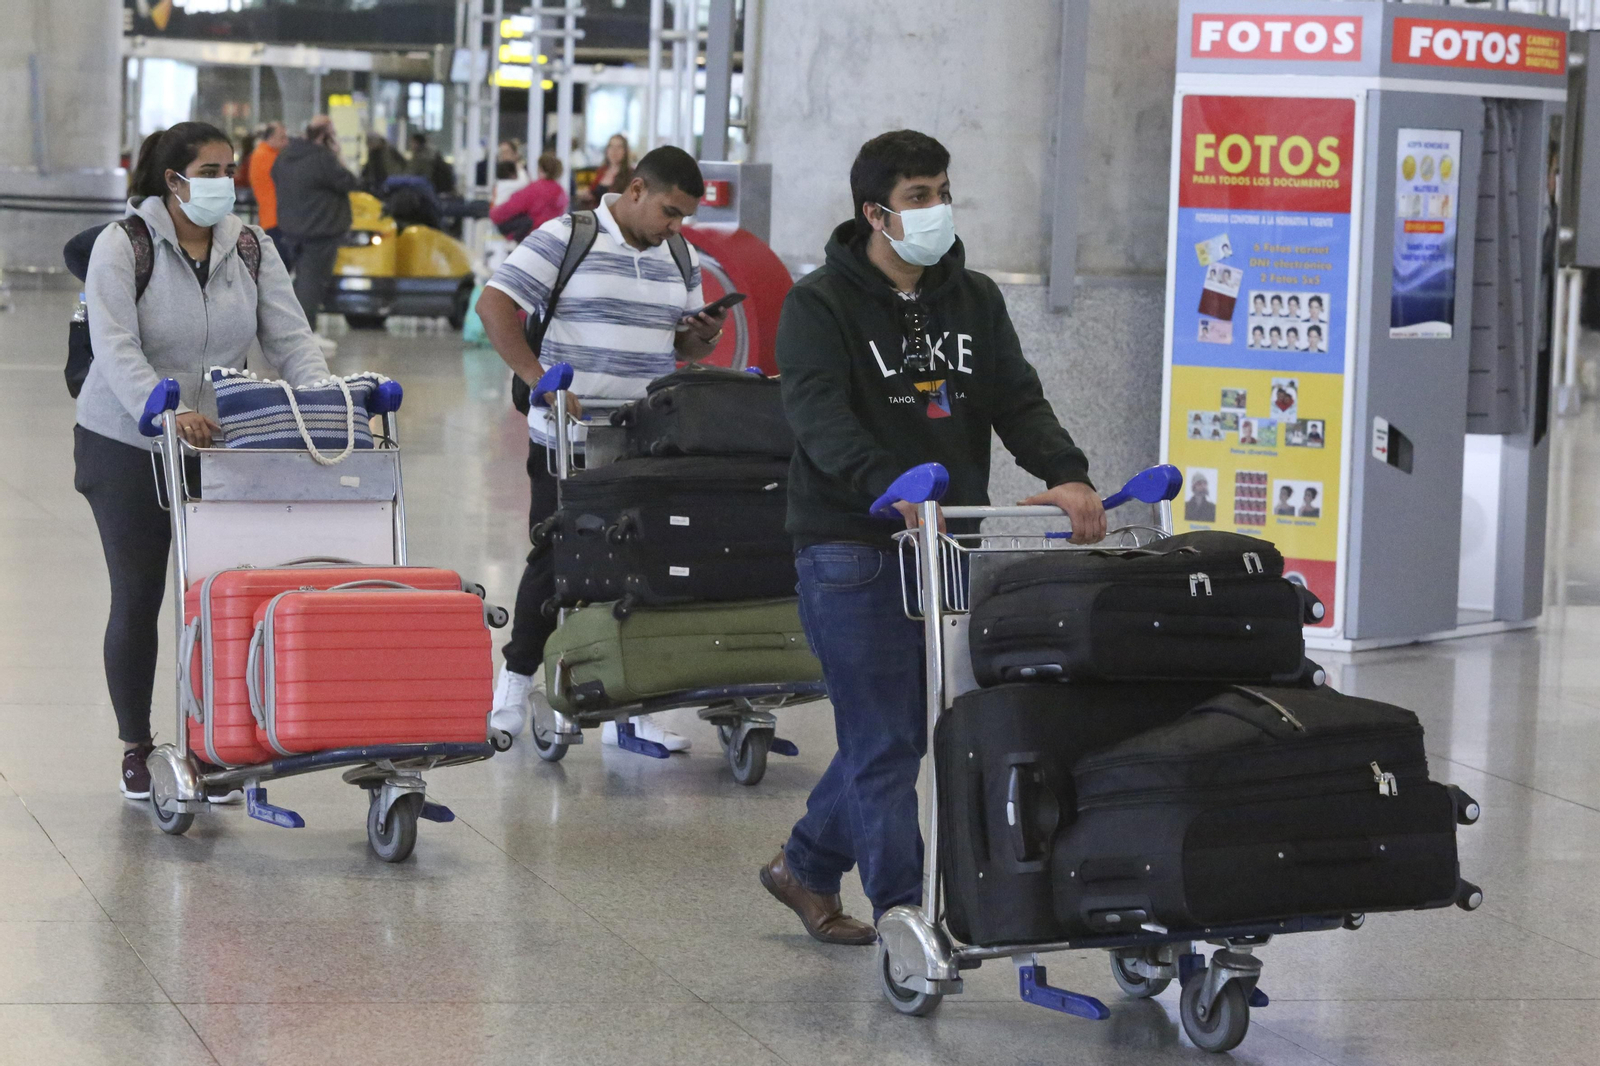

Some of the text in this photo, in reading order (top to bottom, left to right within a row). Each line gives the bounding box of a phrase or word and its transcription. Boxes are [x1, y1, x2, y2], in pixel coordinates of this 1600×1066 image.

[1199, 20, 1355, 54] FOTOS
[1408, 26, 1521, 65] FOTOS
[1194, 133, 1340, 177] FOTOS
[1192, 174, 1339, 189] PARA TODOS LOS DOCUMENTOS
[1249, 258, 1270, 267] DNI
